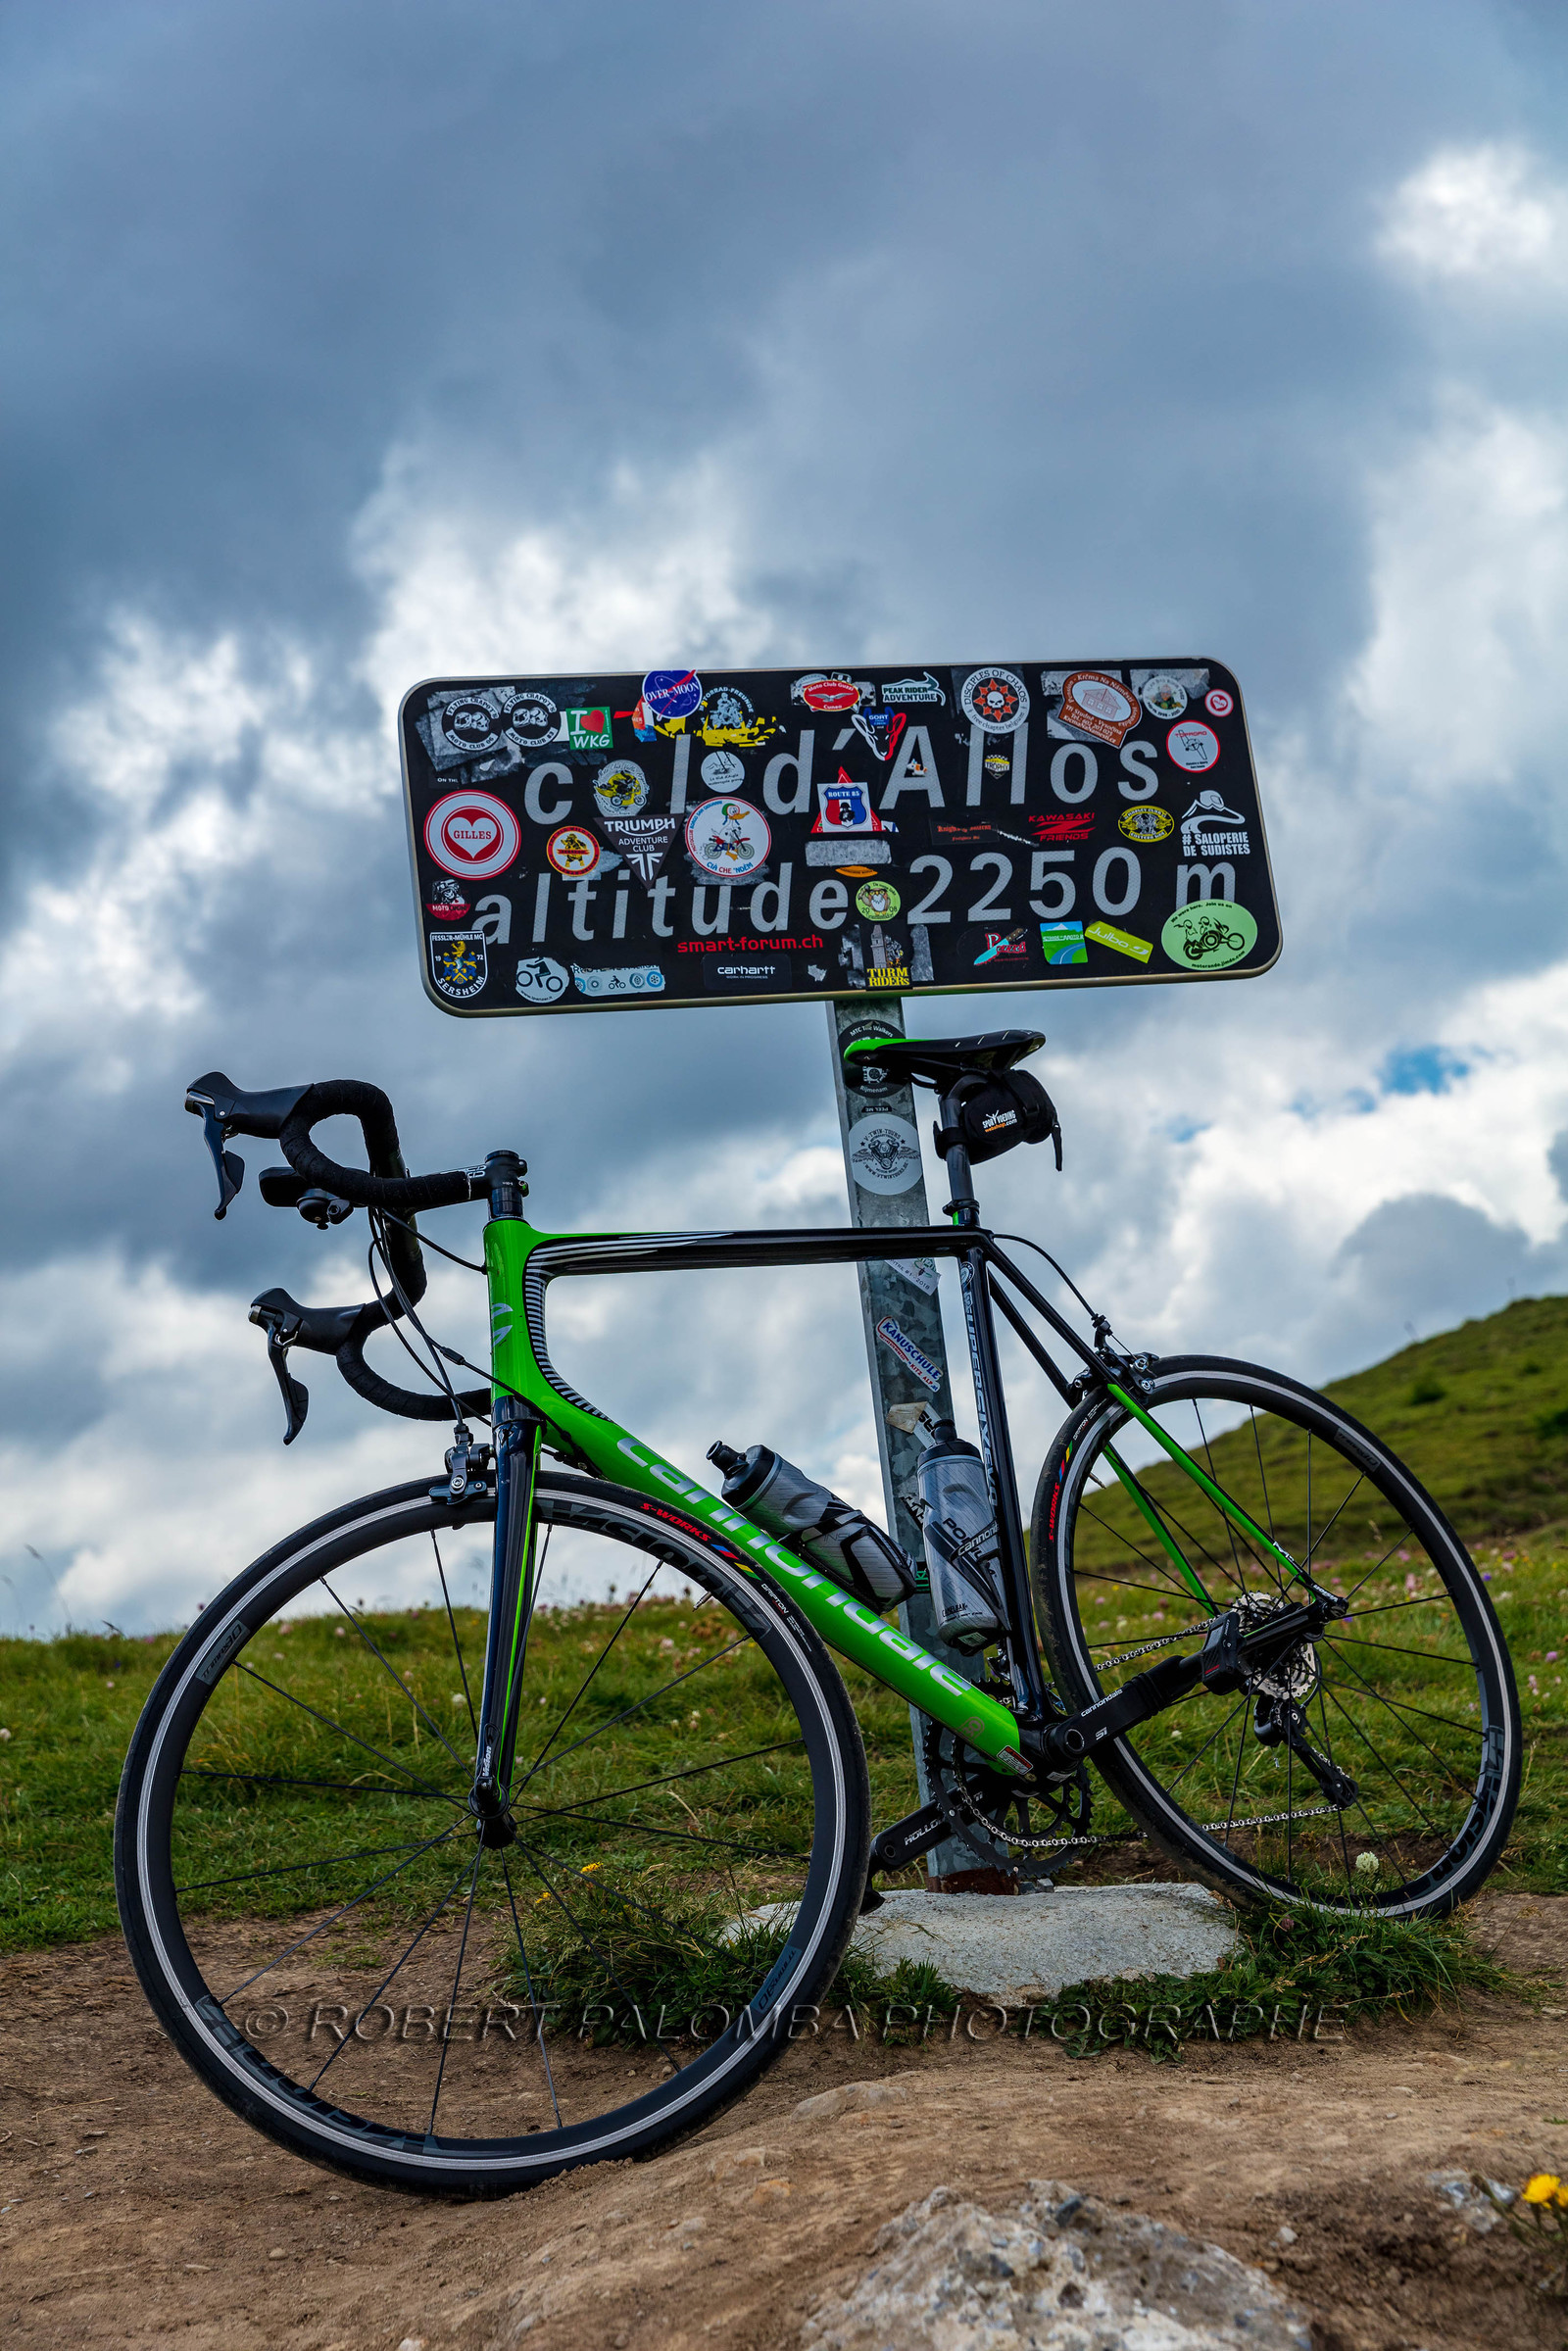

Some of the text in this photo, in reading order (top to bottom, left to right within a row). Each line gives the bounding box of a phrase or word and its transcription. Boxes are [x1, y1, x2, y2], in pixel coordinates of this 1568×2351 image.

[645, 688, 667, 702] OVER
[674, 681, 699, 696] MOON
[808, 683, 823, 693] Moto
[837, 682, 854, 692] Guzzi
[964, 670, 990, 705] DISCIPLES
[1006, 674, 1028, 703] CHAOS
[699, 686, 754, 712] MTORRAD-FREUNDE
[883, 693, 937, 702] ADVENTURE
[448, 734, 467, 748] MOTO
[508, 731, 528, 745] MOTO
[573, 734, 610, 748] WKG
[985, 762, 1010, 771] TROPHY
[1029, 812, 1095, 822] KAWASAKI
[604, 817, 676, 833] TRIUMPH
[453, 830, 491, 840] GILLES
[618, 835, 668, 845] ADVENTURE
[1040, 833, 1089, 842] FRIENDS
[1182, 832, 1249, 845] # SALOPERIE
[633, 844, 655, 853] CLUB
[1183, 843, 1250, 857] DE SUDISTES
[470, 847, 1235, 945] altitude 2250 m
[1178, 908, 1189, 917] were
[677, 934, 824, 954] smart-forum.ch
[1087, 929, 1129, 949] Julbo
[716, 964, 776, 975] carhartt
[867, 967, 908, 978] TURM
[437, 976, 485, 996] SERSHEIM
[882, 1322, 940, 1379] KANUSCHULE
[1048, 1482, 1060, 1543] S-WORKS
[640, 1502, 712, 1543] S-WORKS
[617, 1436, 972, 1697] cannondale
[761, 1583, 789, 1614] GRIPTON
[1080, 1689, 1123, 1717] cannondale
[1095, 1727, 1108, 1740] SI
